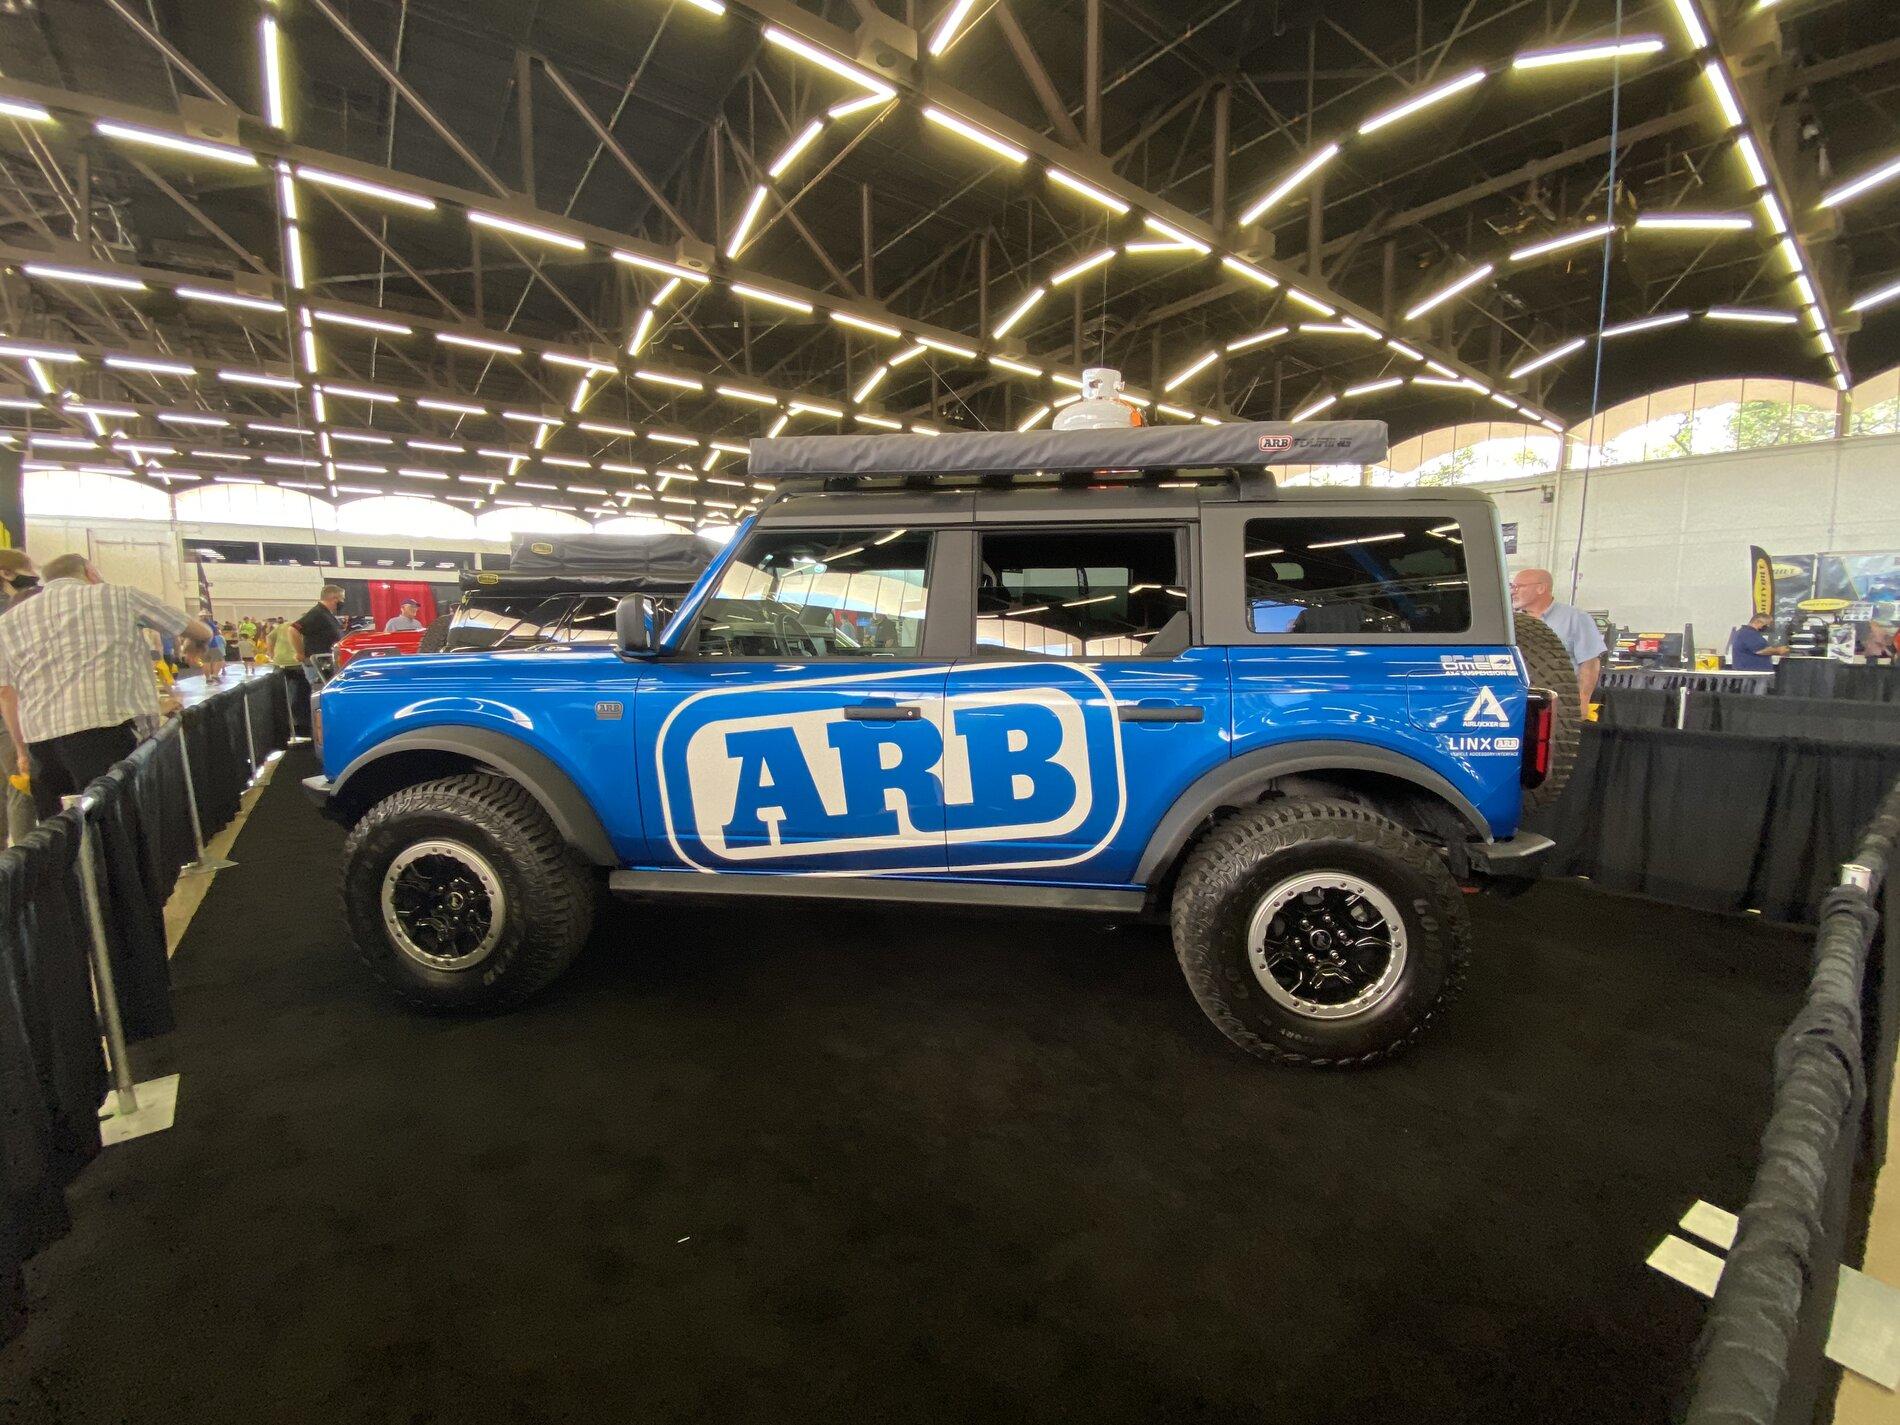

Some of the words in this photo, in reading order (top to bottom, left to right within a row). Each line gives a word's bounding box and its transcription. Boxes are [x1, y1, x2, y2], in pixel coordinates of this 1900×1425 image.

[1263, 438, 1289, 448] ARB
[599, 704, 620, 712] ARB
[1449, 737, 1492, 750] LINX
[721, 703, 1077, 850] ARB
